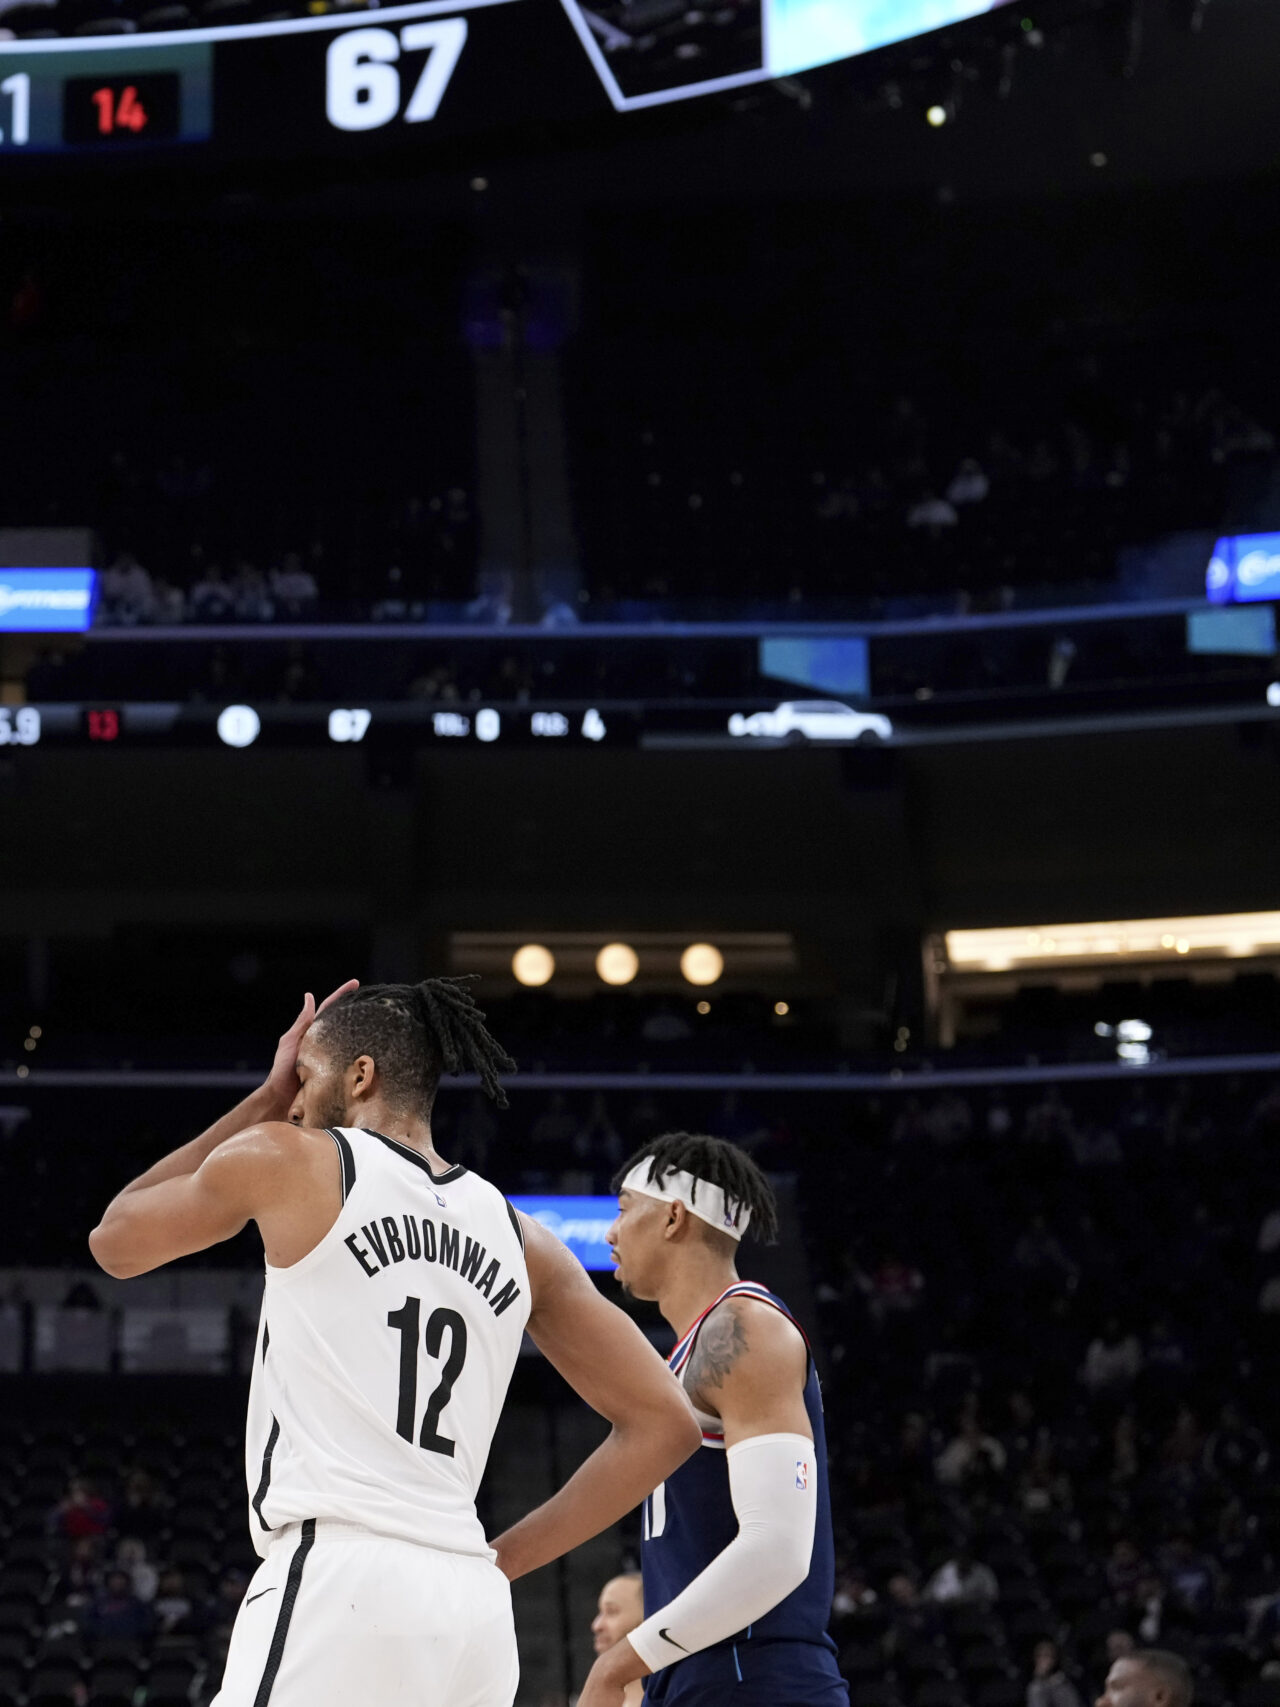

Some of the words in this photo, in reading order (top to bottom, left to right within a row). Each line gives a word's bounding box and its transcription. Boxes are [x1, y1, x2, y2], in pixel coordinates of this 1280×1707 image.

[93, 87, 147, 133] 14
[324, 16, 468, 131] 67
[344, 1215, 521, 1317] EVBUOMWAN
[387, 1296, 468, 1459] 12
